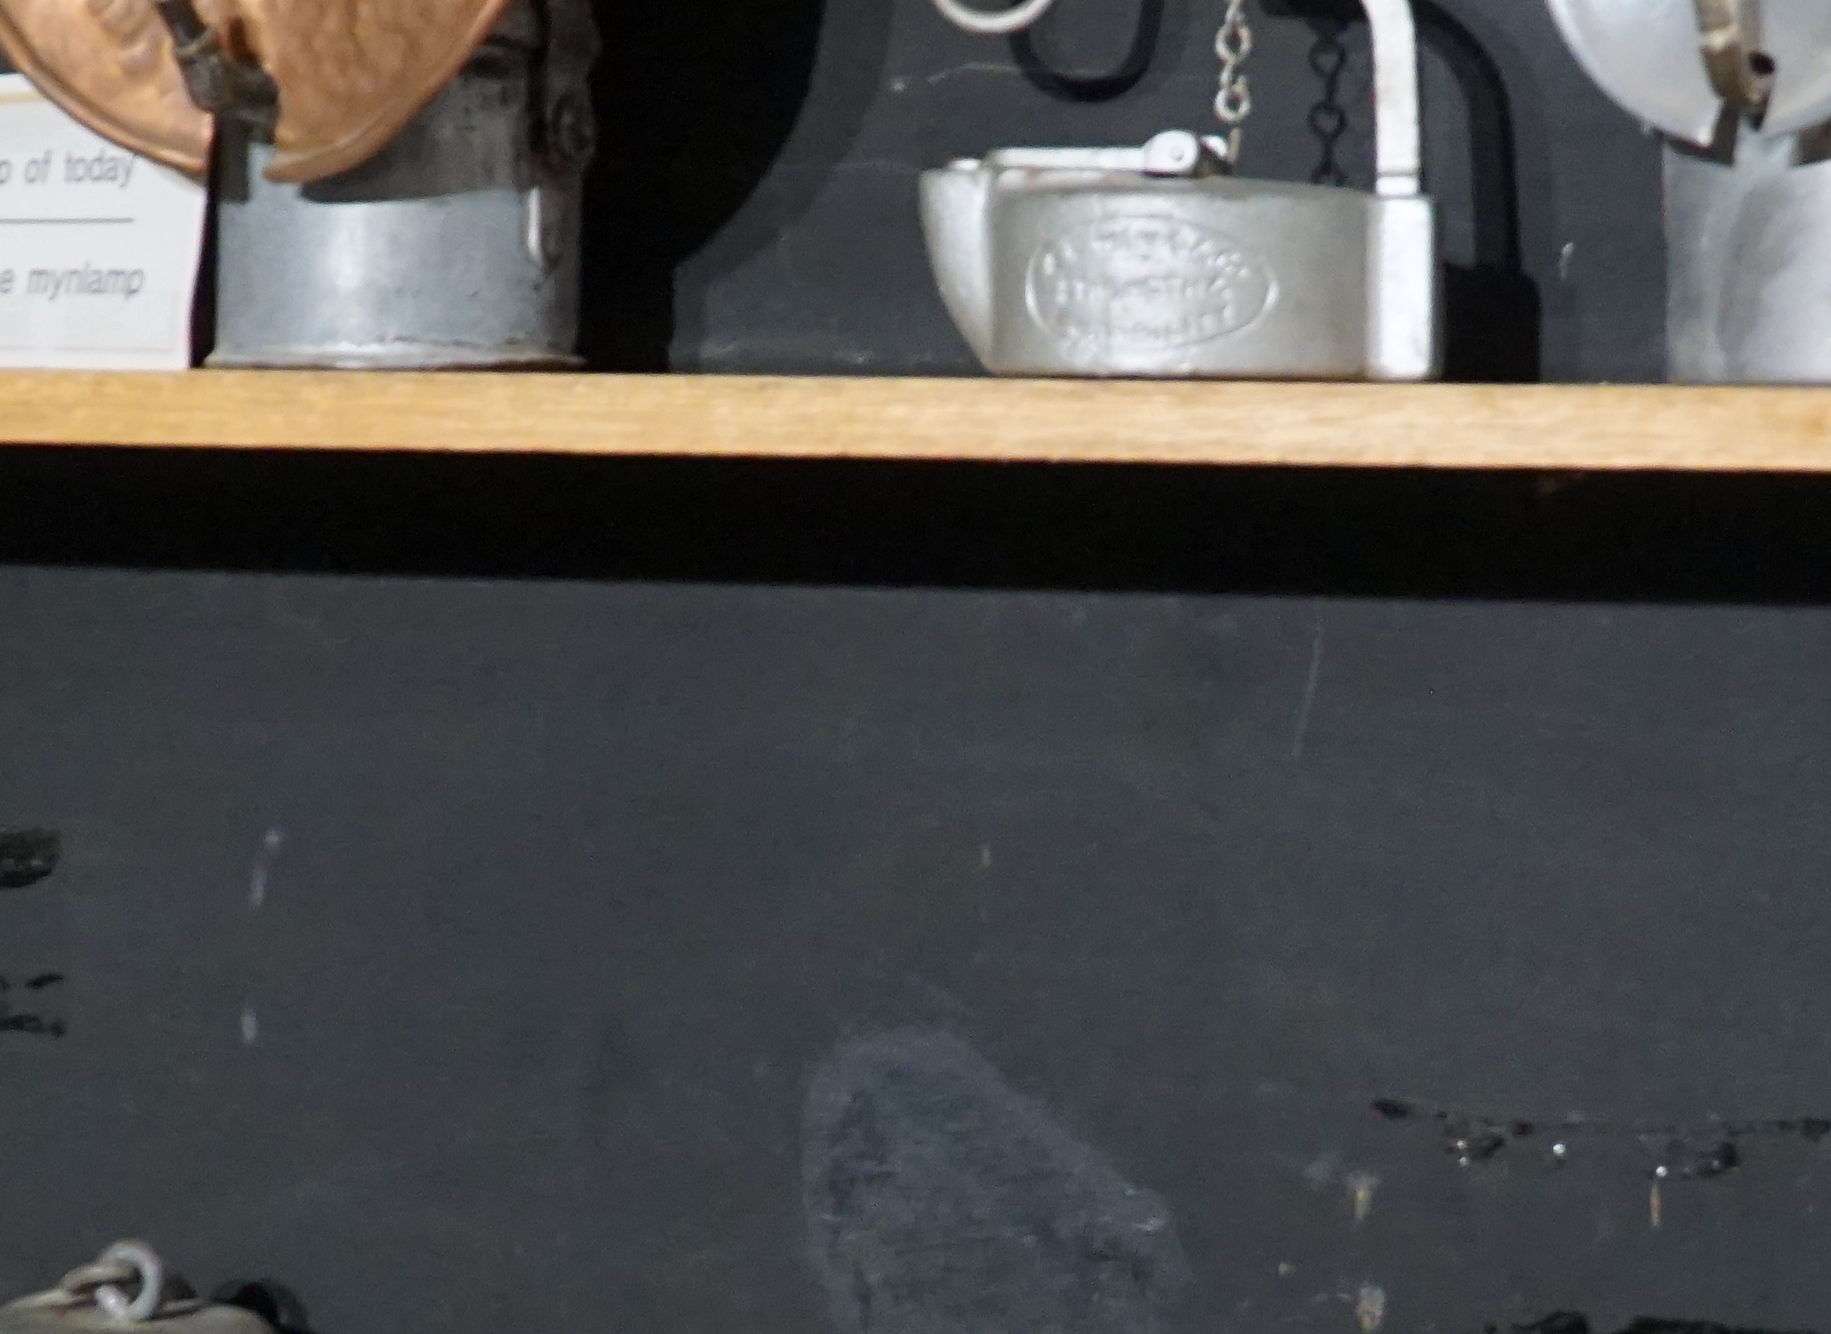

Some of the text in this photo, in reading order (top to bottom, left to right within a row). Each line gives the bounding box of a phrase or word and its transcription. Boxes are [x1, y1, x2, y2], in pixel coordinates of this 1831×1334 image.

[25, 148, 58, 184] of
[64, 149, 136, 188] today
[26, 261, 145, 303] mynlamp
